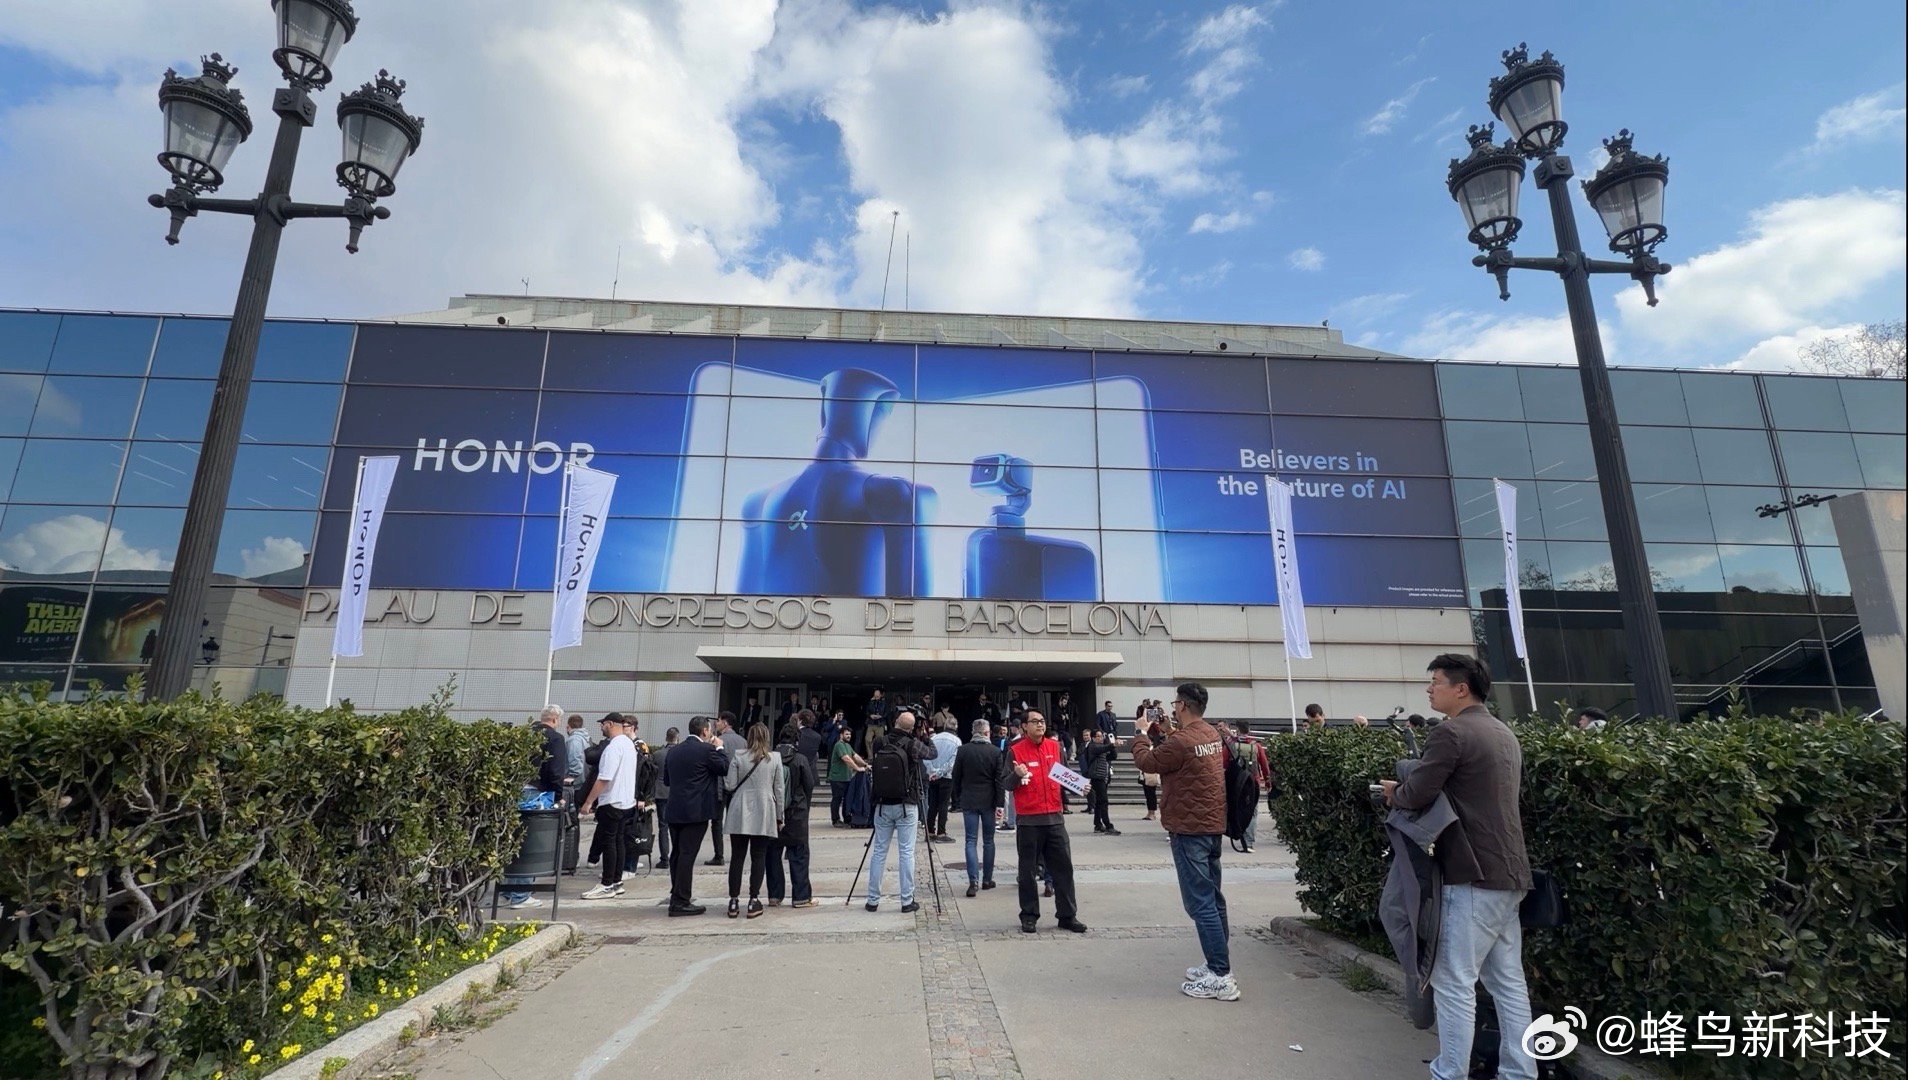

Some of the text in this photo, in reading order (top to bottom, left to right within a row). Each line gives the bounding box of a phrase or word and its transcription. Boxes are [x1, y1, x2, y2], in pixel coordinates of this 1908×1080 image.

[414, 438, 595, 474] HONOR
[1239, 448, 1378, 472] Believers in
[1217, 475, 1259, 496] the
[1351, 479, 1375, 499] of
[1382, 480, 1406, 500] AI
[469, 592, 525, 625] DE
[585, 594, 834, 630] ONGRESSOS
[865, 602, 914, 632] DE
[945, 602, 1171, 636] BARCELONA
